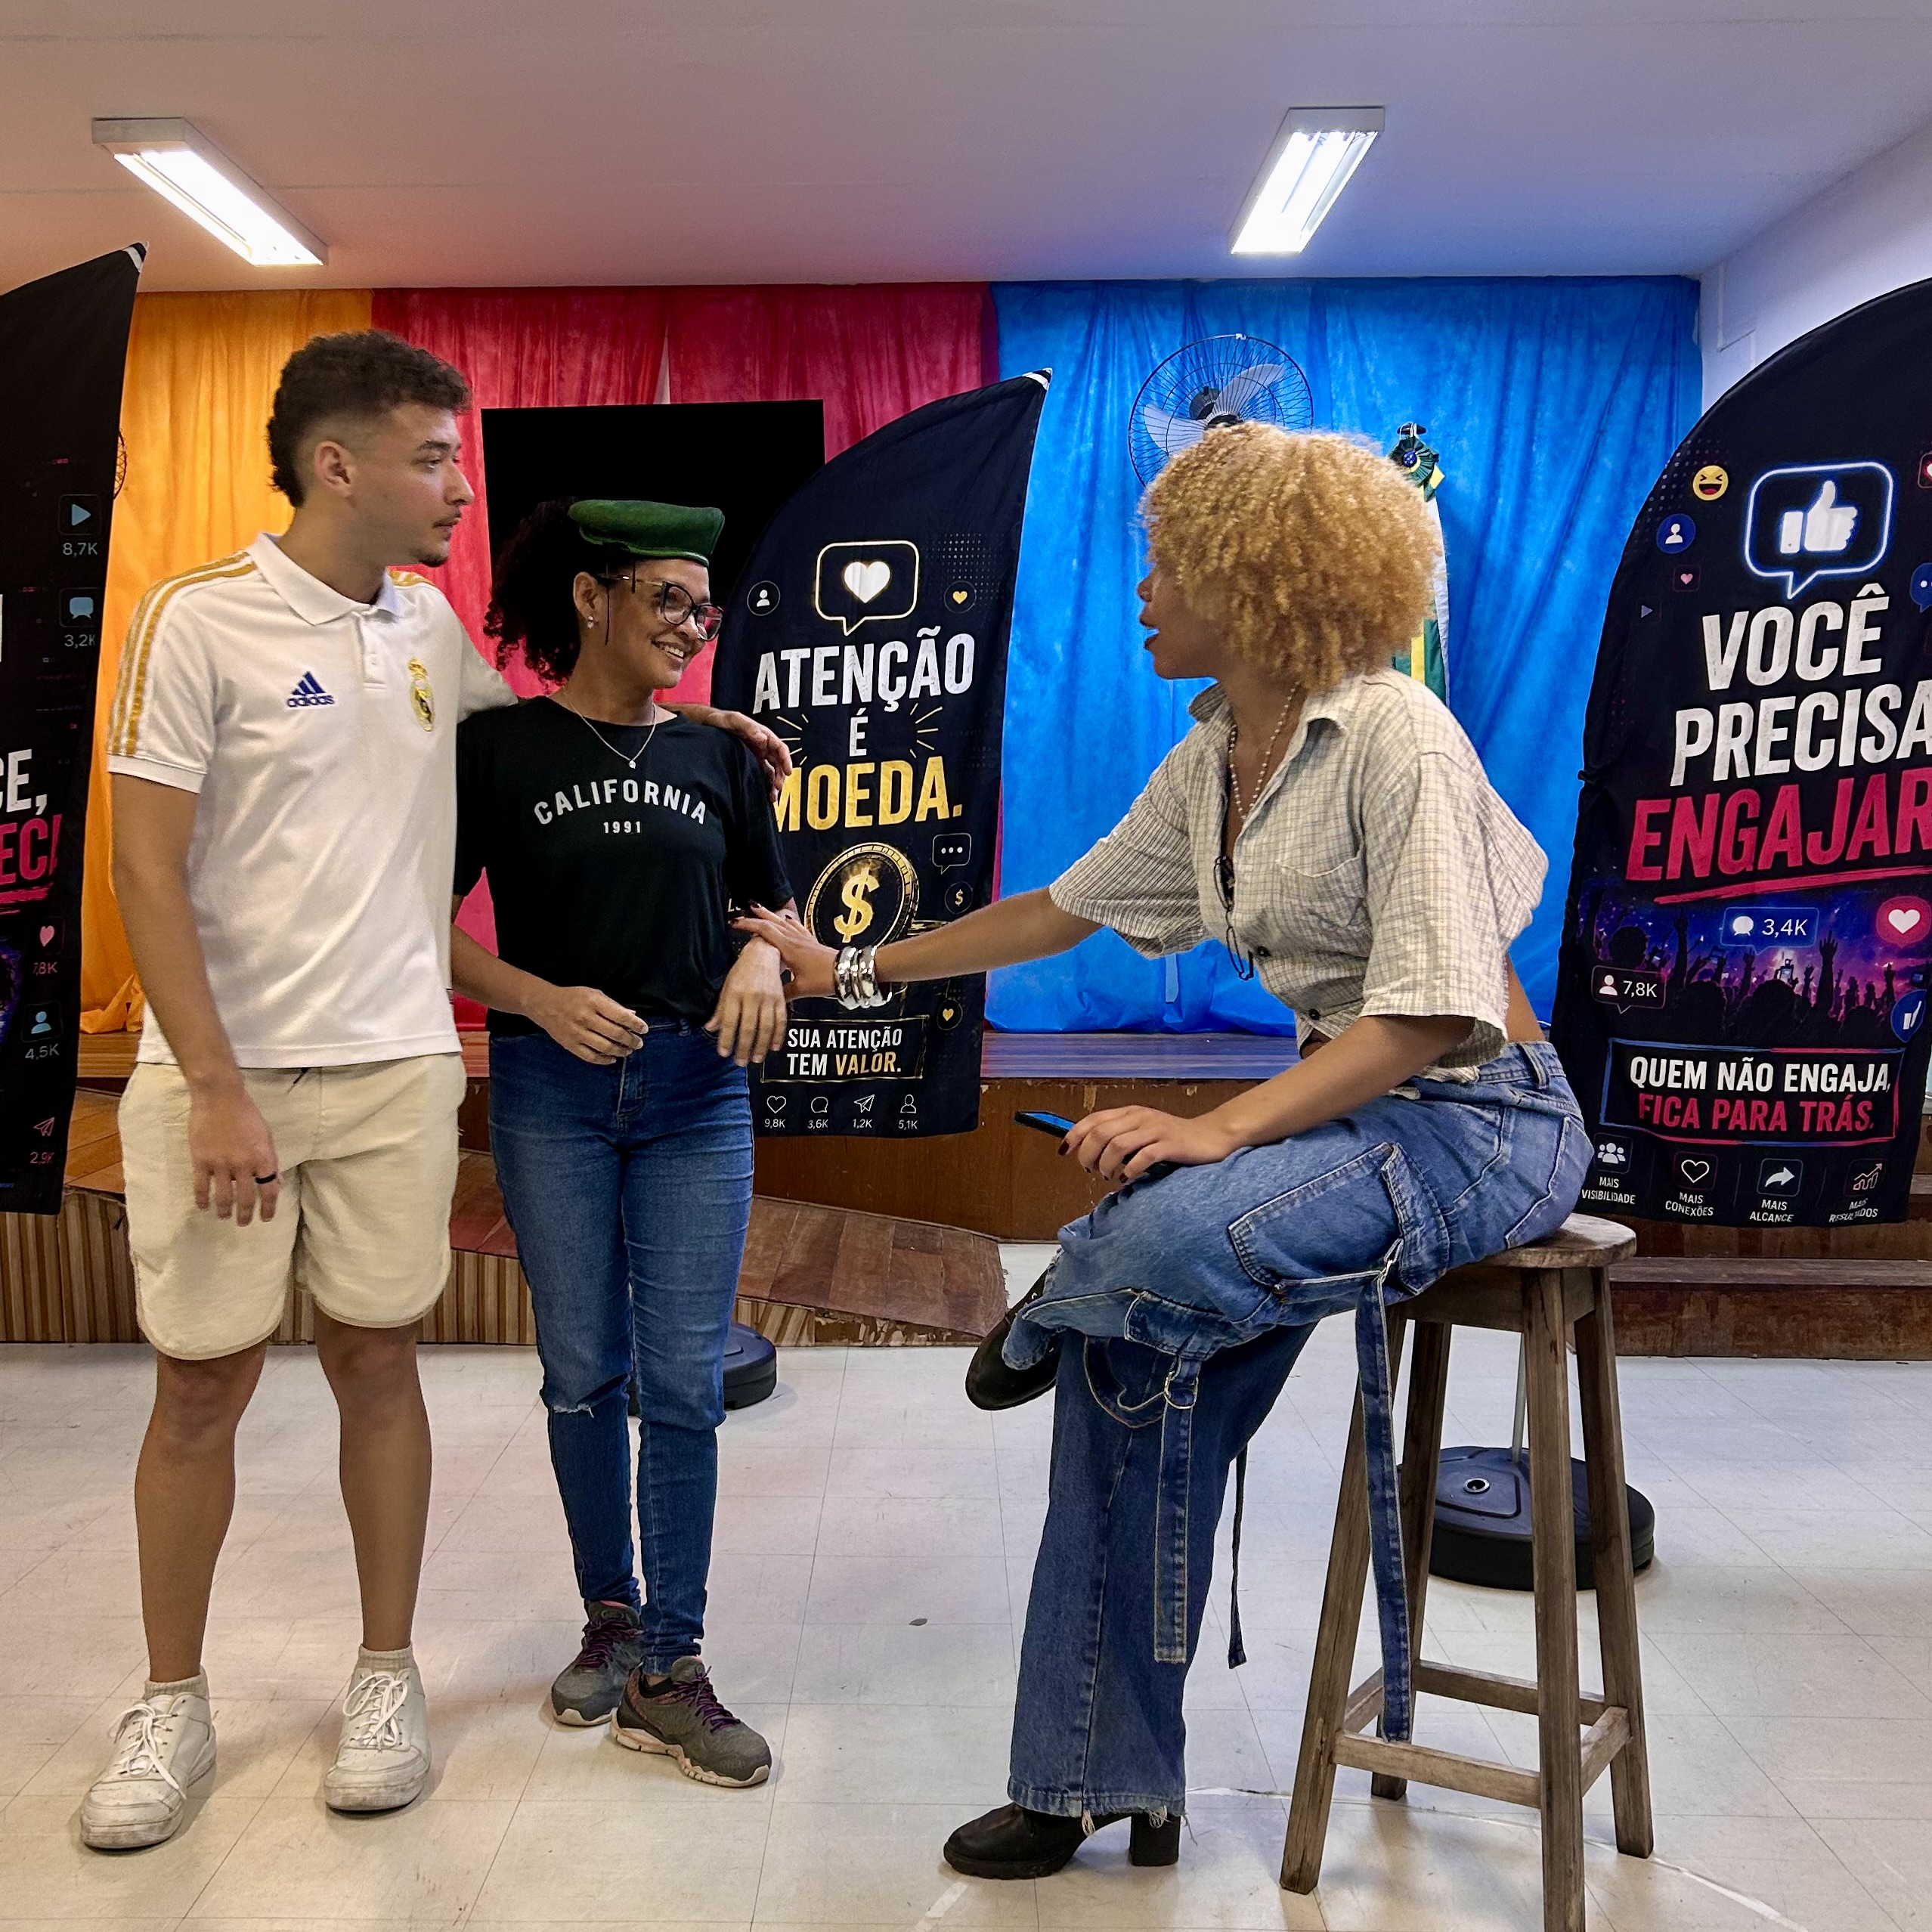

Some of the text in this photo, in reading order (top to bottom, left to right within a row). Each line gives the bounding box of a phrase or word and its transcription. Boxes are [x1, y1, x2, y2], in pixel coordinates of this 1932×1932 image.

[62, 543, 98, 557] 8,7K
[64, 634, 96, 649] 3,2K
[1701, 583, 1890, 691] VOCÊ
[753, 626, 975, 714] ATENÇÃO
[286, 695, 335, 707] adidas
[849, 707, 868, 757] É
[1670, 680, 1932, 787] PRECISA
[0, 748, 48, 815] E,
[534, 779, 706, 825] CALIFORNIA
[773, 756, 963, 832] MOEDA.
[603, 821, 642, 834] 1991
[1625, 766, 1932, 881] ENGAJAR
[1762, 918, 1807, 938] 3,4K
[1623, 980, 1657, 999] 7,8K
[788, 1026, 903, 1052] SUA ATENÇÃO
[25, 1043, 59, 1060] 4,5K
[787, 1051, 902, 1076] TEM VALOR.
[1630, 1056, 1891, 1093] QUEM NÃO ENGAJA,
[1638, 1093, 1874, 1132] FICA PARA TRÁS.
[764, 1119, 785, 1129] 9,8K
[807, 1119, 829, 1129] 3,6K
[852, 1119, 872, 1129] 1,2K
[898, 1119, 918, 1130] 5,1K
[1599, 1176, 1620, 1188] MAIS
[1679, 1192, 1704, 1203] MAIS
[1761, 1199, 1788, 1211] MAIS
[1665, 1200, 1714, 1217] CONEXÕES
[1749, 1211, 1794, 1222] ALCANCE
